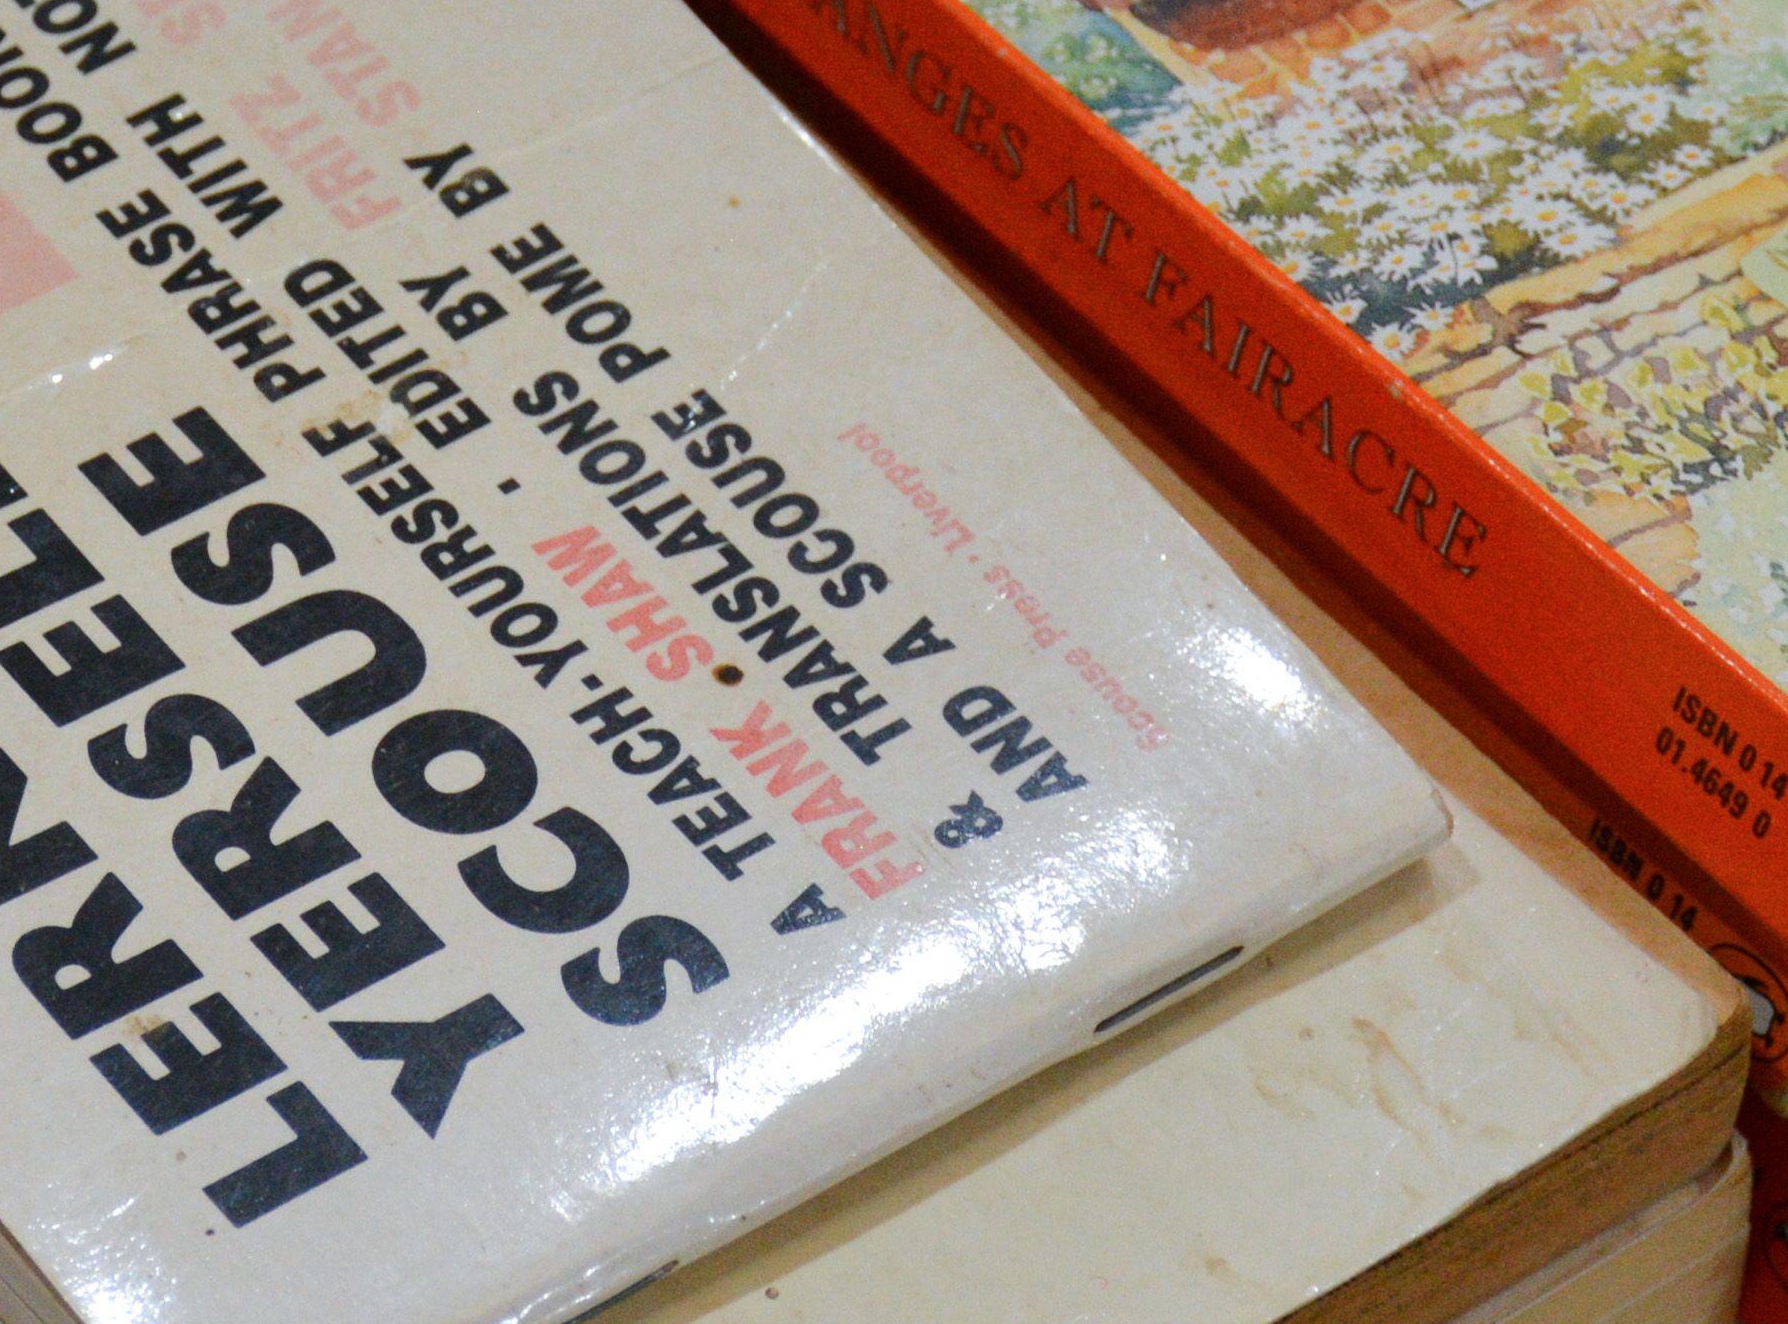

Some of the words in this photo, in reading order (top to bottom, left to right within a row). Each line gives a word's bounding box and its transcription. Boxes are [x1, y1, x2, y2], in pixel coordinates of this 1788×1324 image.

[125, 92, 284, 240] WITH
[227, 74, 404, 232] FRITZ
[403, 142, 510, 220] BY
[96, 188, 327, 404] PHRASE
[283, 258, 492, 450] EDITED
[401, 266, 510, 343] BY
[489, 222, 672, 385] POME
[1041, 175, 1135, 269] AT
[1143, 252, 1489, 580] FAIRACRE
[648, 387, 894, 610] SCOUSE
[835, 422, 975, 553] Liverpool
[511, 369, 914, 767] TRANSLATIONS
[530, 523, 715, 682] SHAW
[982, 564, 1070, 649] Press
[881, 615, 958, 667] A
[1064, 646, 1172, 752] Scouse
[76, 406, 731, 1027] SCOUSE
[940, 684, 1091, 804] AND
[1672, 686, 1739, 756] ISBN
[1739, 744, 1757, 772] 0
[1761, 761, 1788, 800] 14
[708, 699, 928, 900] FRANK
[933, 789, 1005, 849] &
[1752, 810, 1771, 838] 0
[769, 882, 848, 937] A
[1589, 818, 1644, 881] ISBN
[1647, 874, 1665, 901] 0
[1671, 895, 1698, 932] 14
